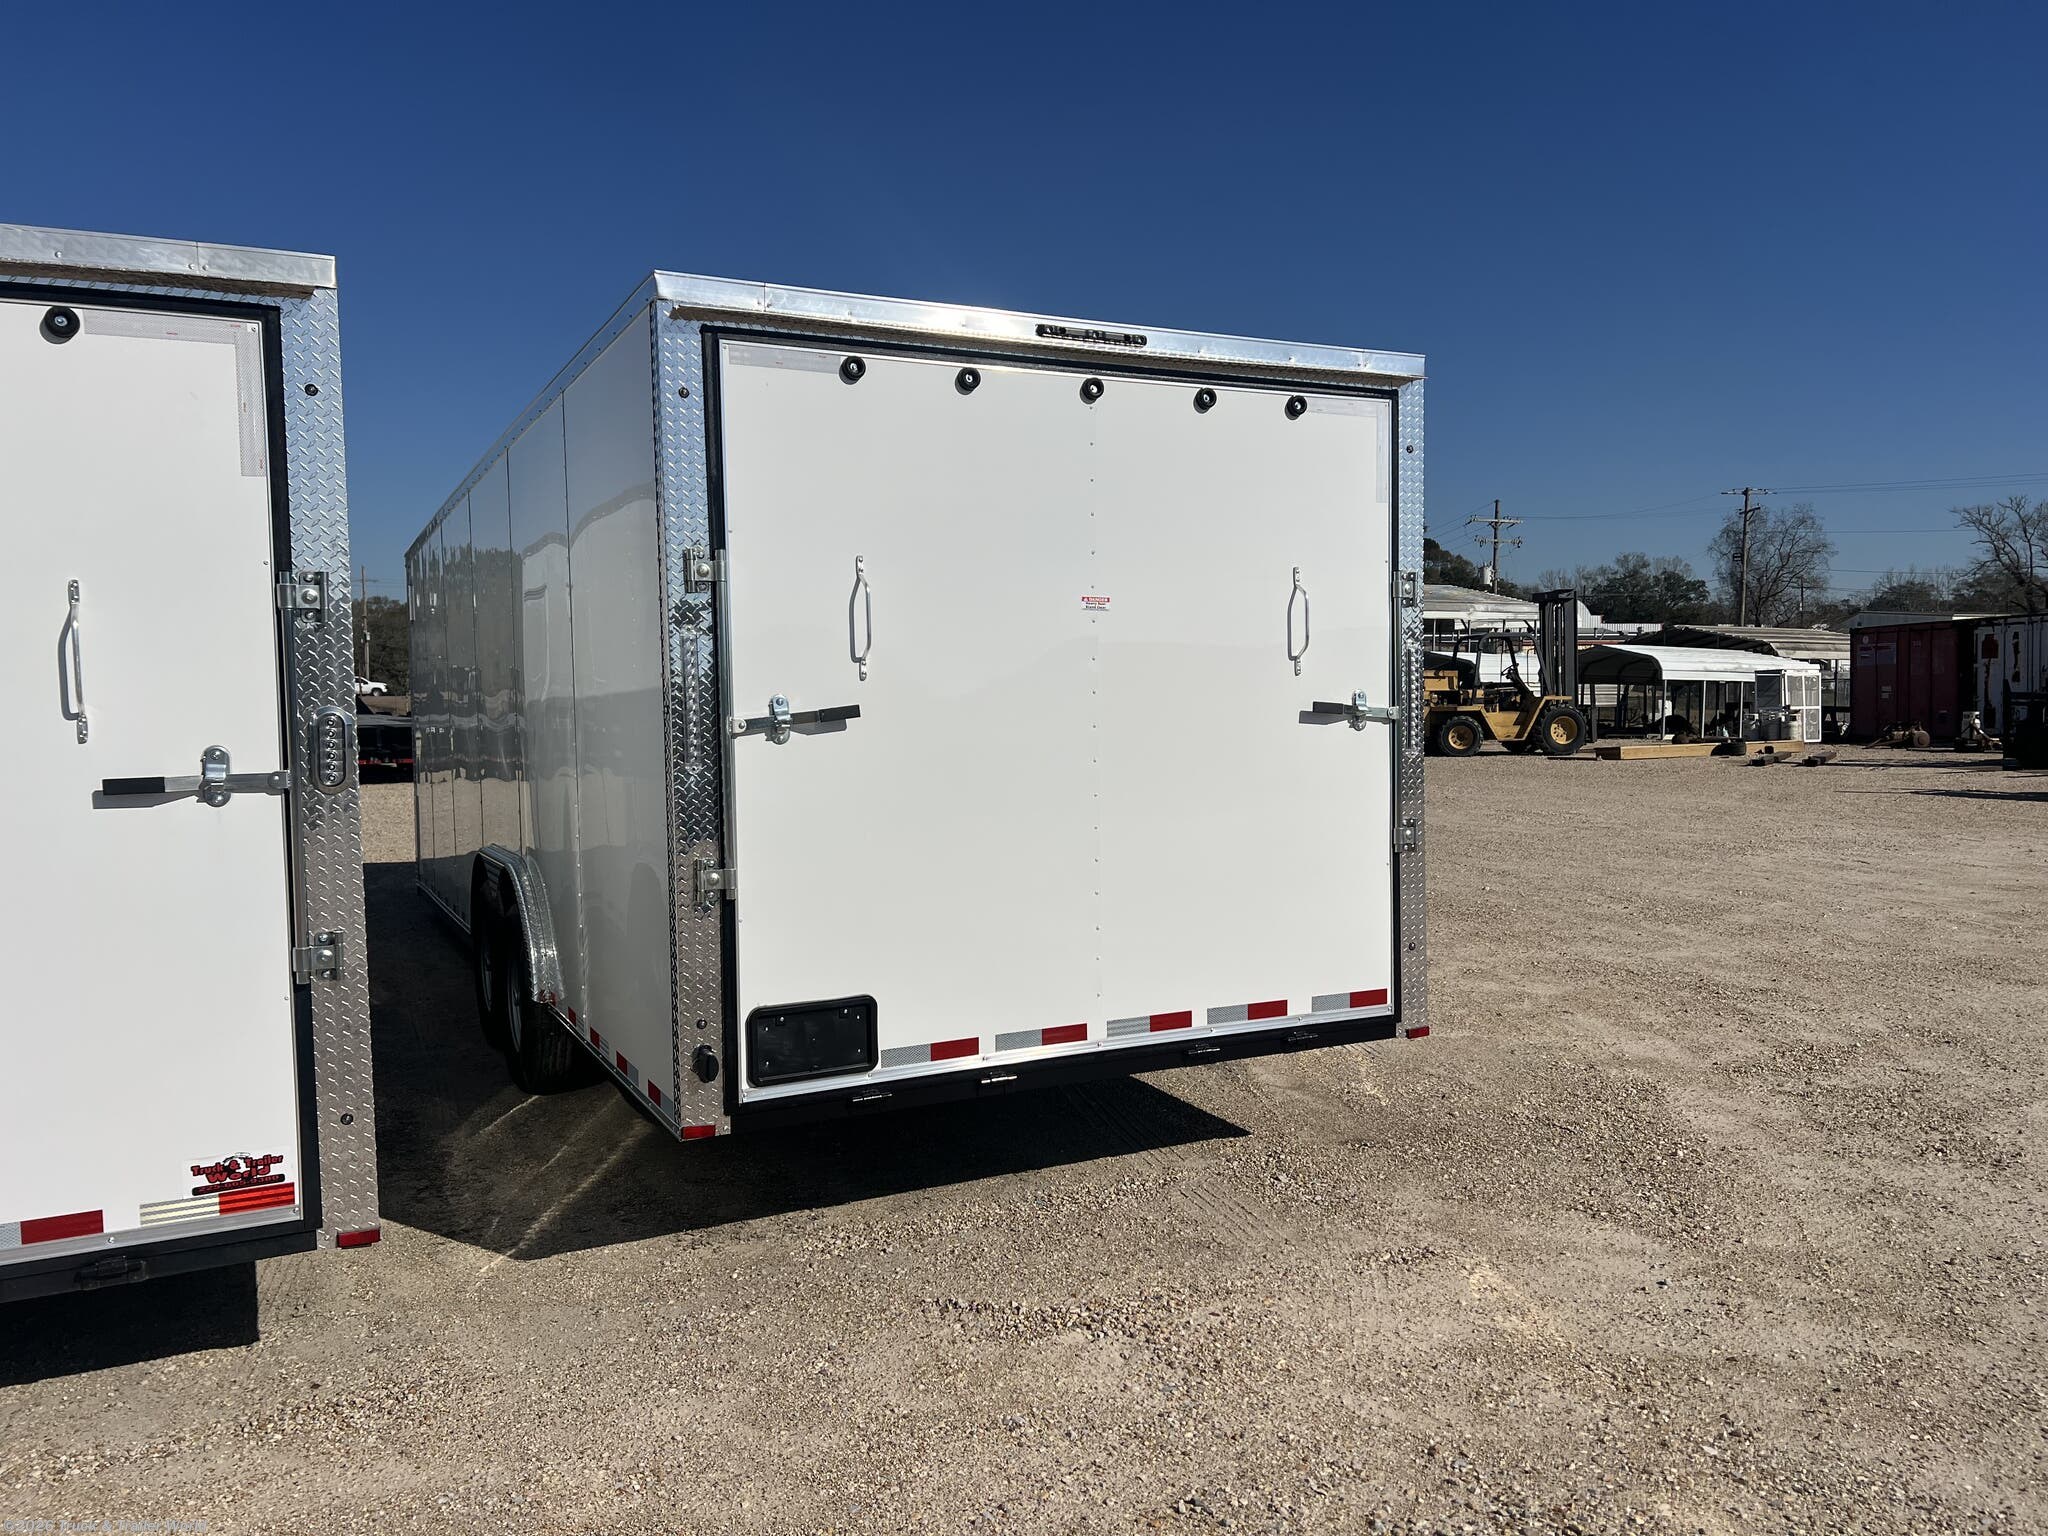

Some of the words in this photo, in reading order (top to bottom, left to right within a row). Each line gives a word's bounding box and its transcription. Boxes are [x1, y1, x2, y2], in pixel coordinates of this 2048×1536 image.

[192, 1163, 224, 1177] Truck
[230, 1160, 240, 1170] &
[245, 1155, 284, 1168] Trailer
[206, 1166, 271, 1183] World
